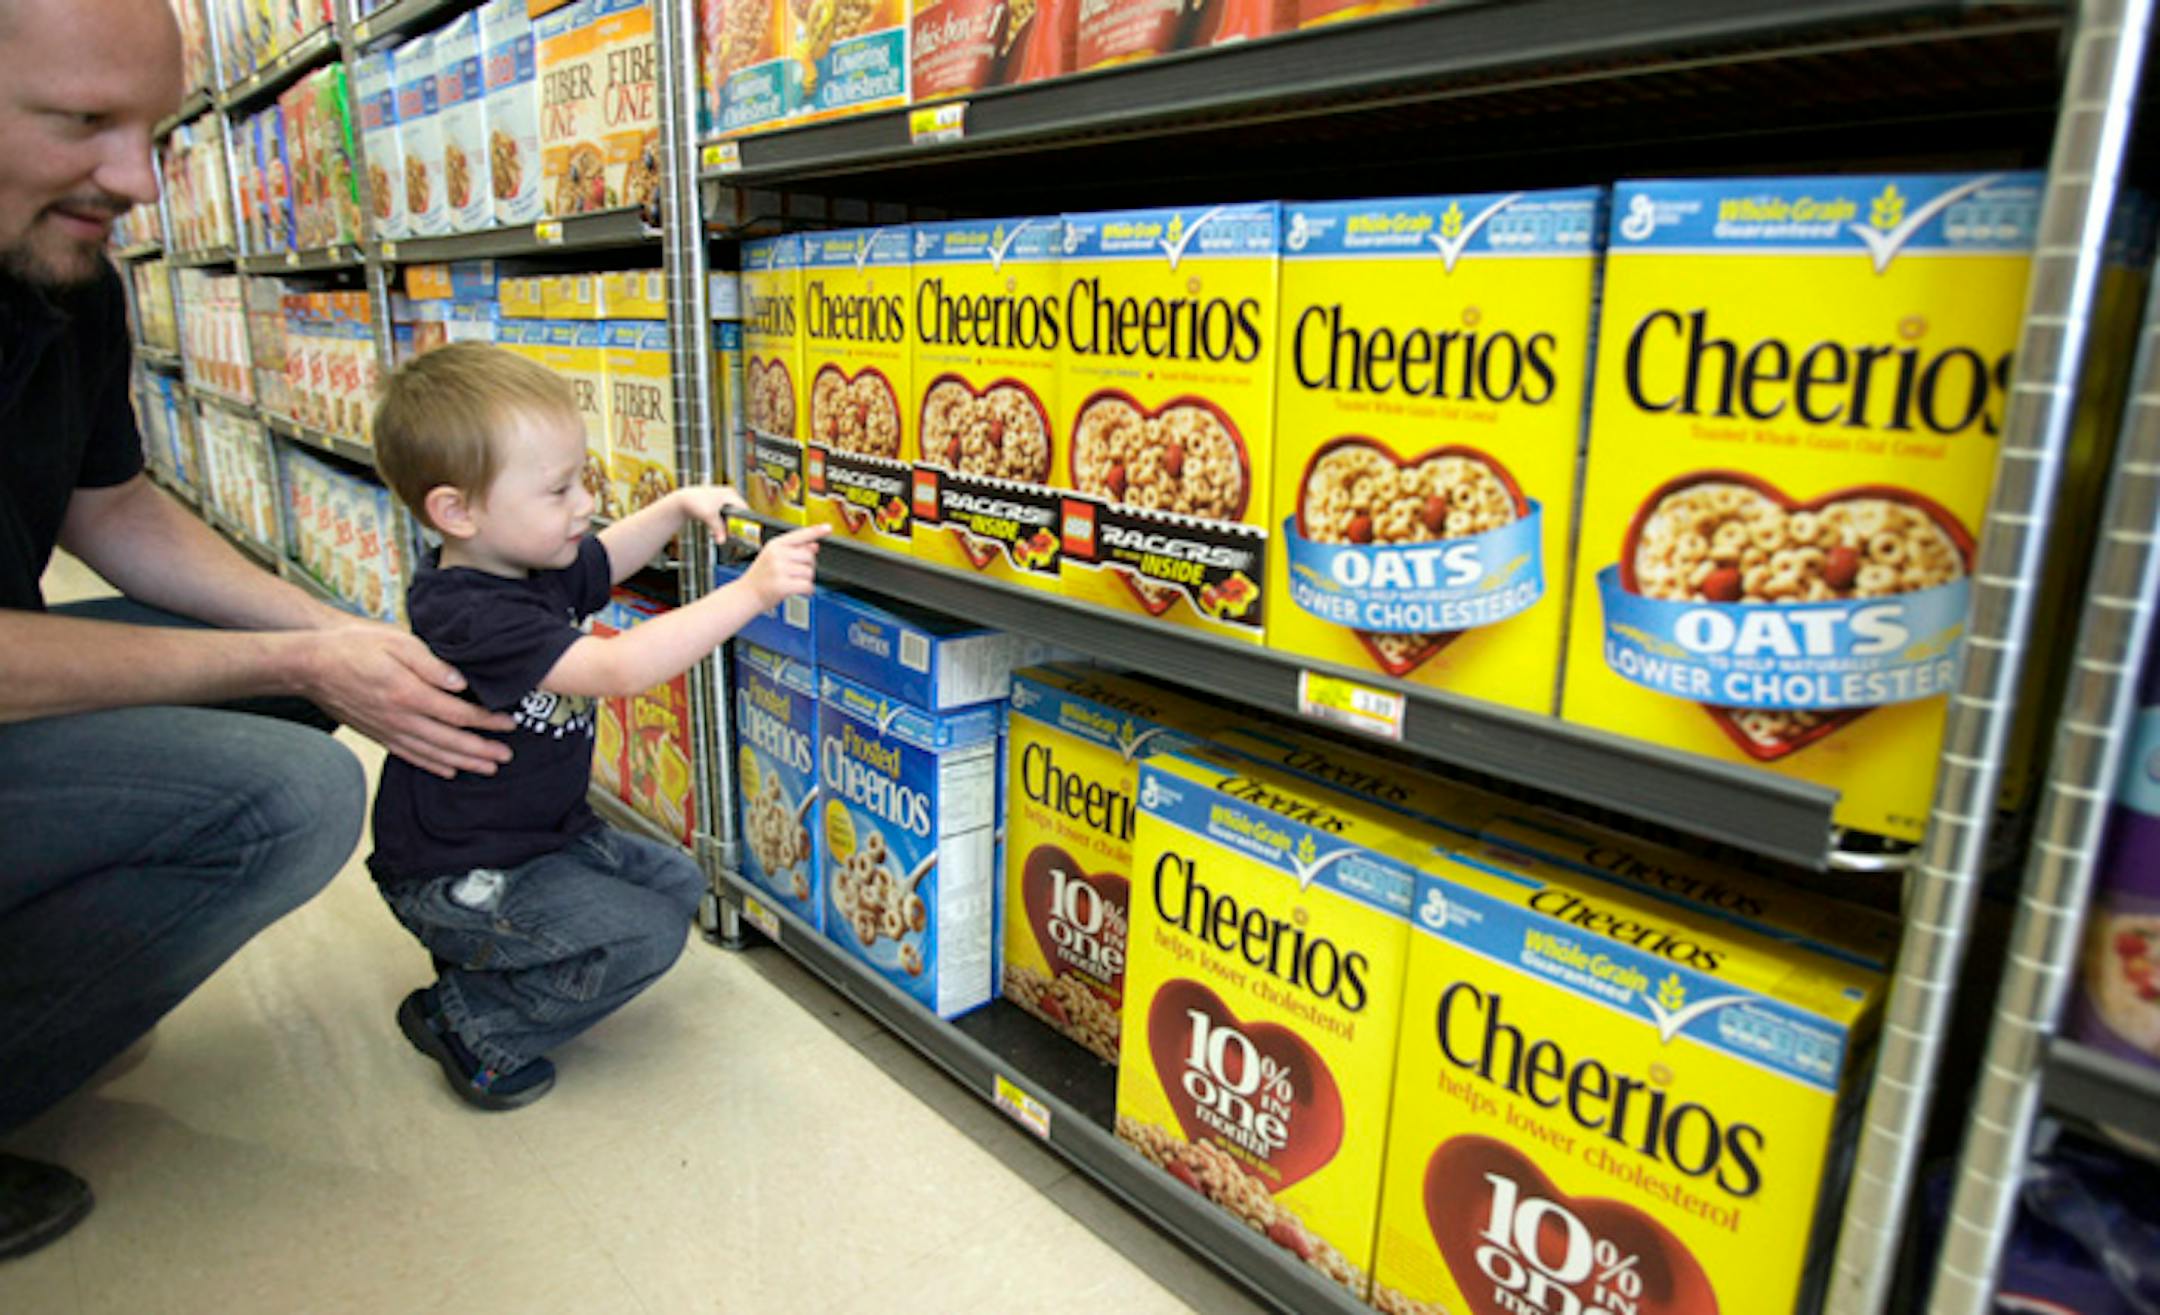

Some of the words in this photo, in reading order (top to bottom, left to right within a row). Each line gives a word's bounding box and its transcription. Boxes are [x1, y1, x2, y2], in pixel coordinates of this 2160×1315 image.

[607, 44, 655, 87] FIBE
[807, 279, 905, 344] Cheerios
[917, 277, 1060, 350] Cheerios
[1066, 276, 1262, 364] Cheerios
[1292, 303, 1557, 406] Cheerios
[1100, 524, 1253, 569] RACERS
[1141, 552, 1206, 585] INSIDE
[1331, 543, 1483, 589] OATS
[1673, 604, 1910, 656] OATS
[1604, 640, 1713, 699] LOWER
[1723, 657, 1956, 706] CHOLESTER
[821, 736, 931, 839] Cheerios
[842, 724, 901, 779] Frosted
[1021, 741, 1136, 845] Cheeri
[1047, 918, 1124, 975] one
[1153, 851, 1369, 1013] Cheerios
[1528, 889, 1726, 972] Cheerios
[1182, 1069, 1290, 1151] one
[1435, 980, 1765, 1199] Cheerios
[1438, 1068, 1500, 1116] helps
[1504, 1103, 1576, 1157] lower
[1582, 1144, 1742, 1234] cholesterol
